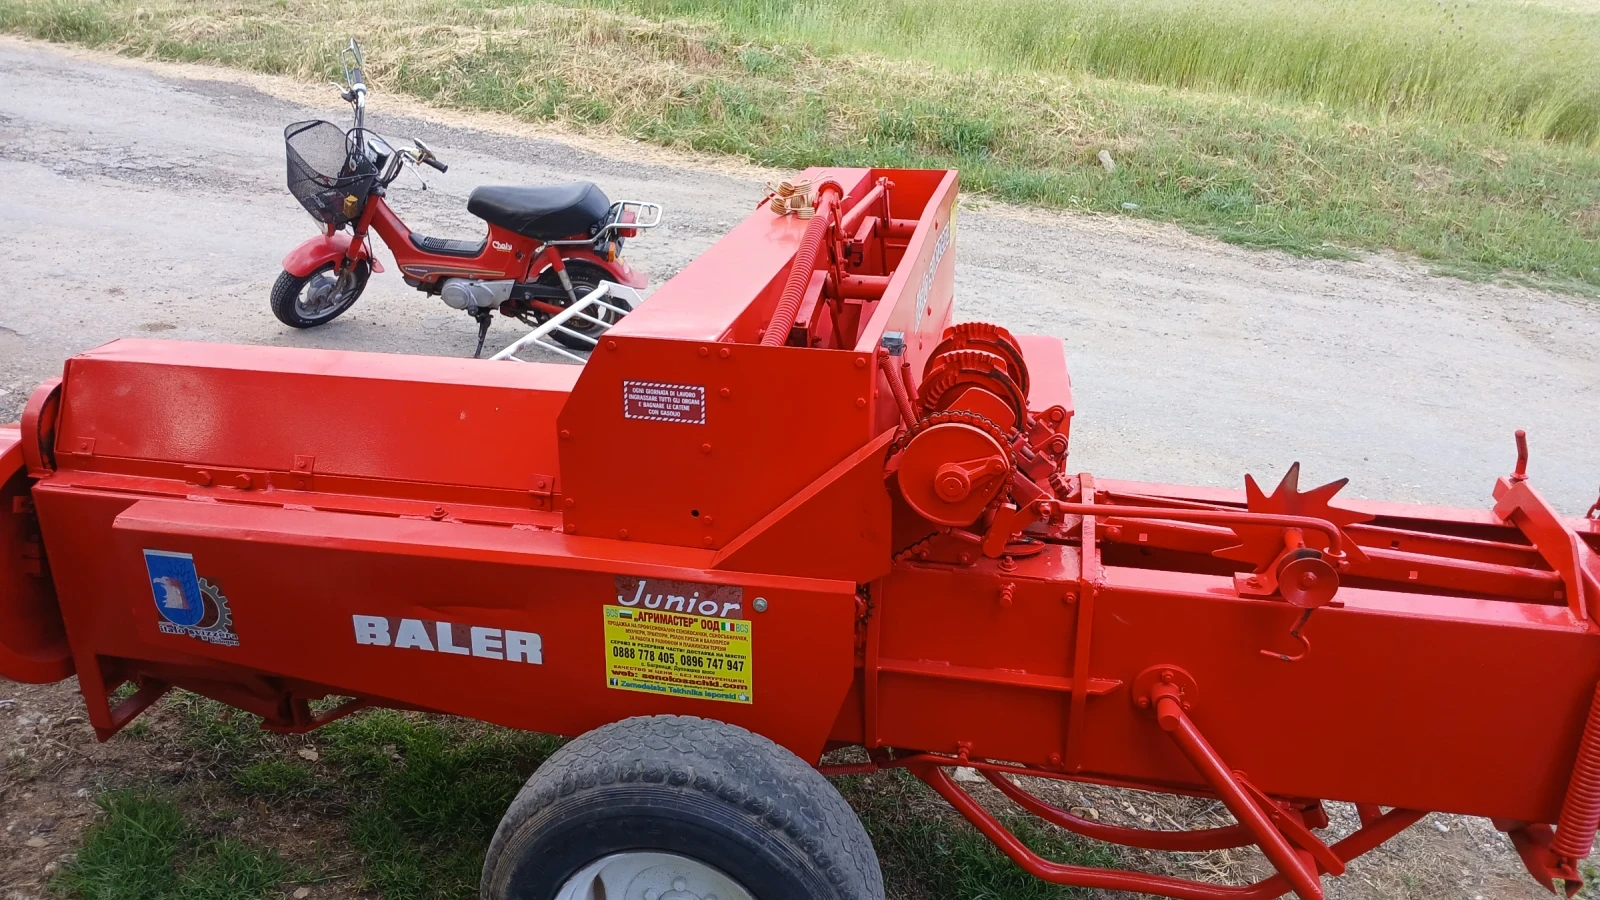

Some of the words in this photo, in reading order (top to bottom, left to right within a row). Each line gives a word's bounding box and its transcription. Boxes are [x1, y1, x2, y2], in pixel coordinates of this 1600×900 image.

[645, 388, 669, 396] GIORNATA
[617, 580, 741, 617] Junior
[160, 625, 186, 634] italo
[701, 619, 720, 633] ООД
[736, 623, 748, 633] BCS
[352, 614, 543, 665] BALER
[613, 645, 636, 659] 0888
[638, 648, 655, 662] 778
[680, 654, 703, 668] 0896
[706, 657, 724, 670] 747
[727, 660, 744, 672] 947
[613, 664, 646, 672] КАЧЕСТВО
[611, 669, 638, 678] web:
